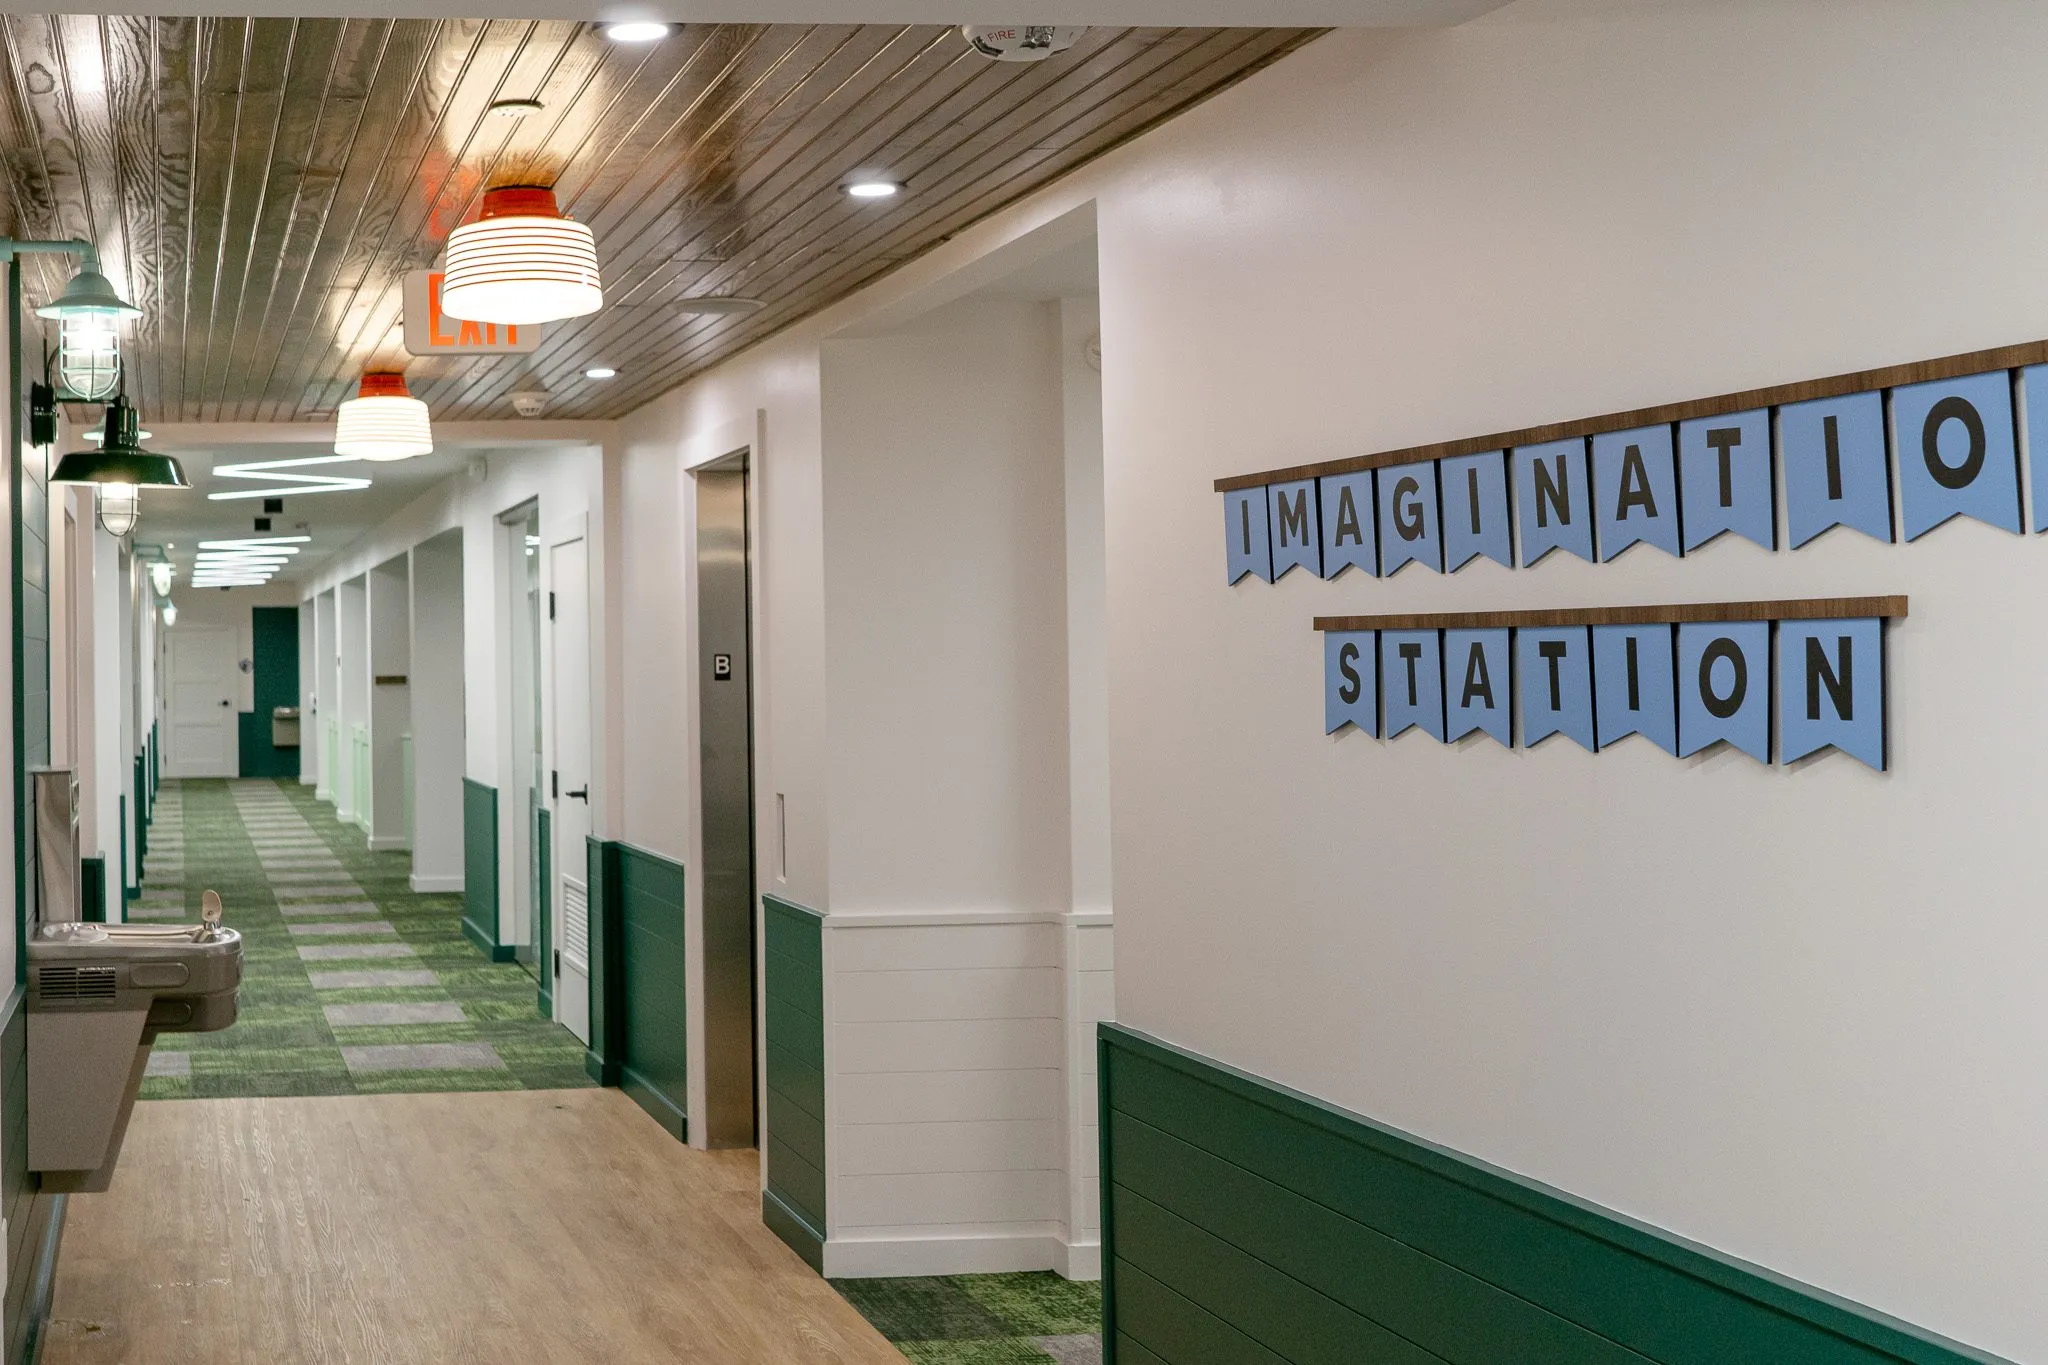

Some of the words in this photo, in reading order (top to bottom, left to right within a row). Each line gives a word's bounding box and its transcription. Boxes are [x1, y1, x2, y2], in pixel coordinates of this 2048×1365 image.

[988, 29, 1017, 42] FIRE
[1240, 396, 1986, 555] IMAGINATIO
[715, 656, 730, 674] B
[1338, 636, 1853, 721] STATION
